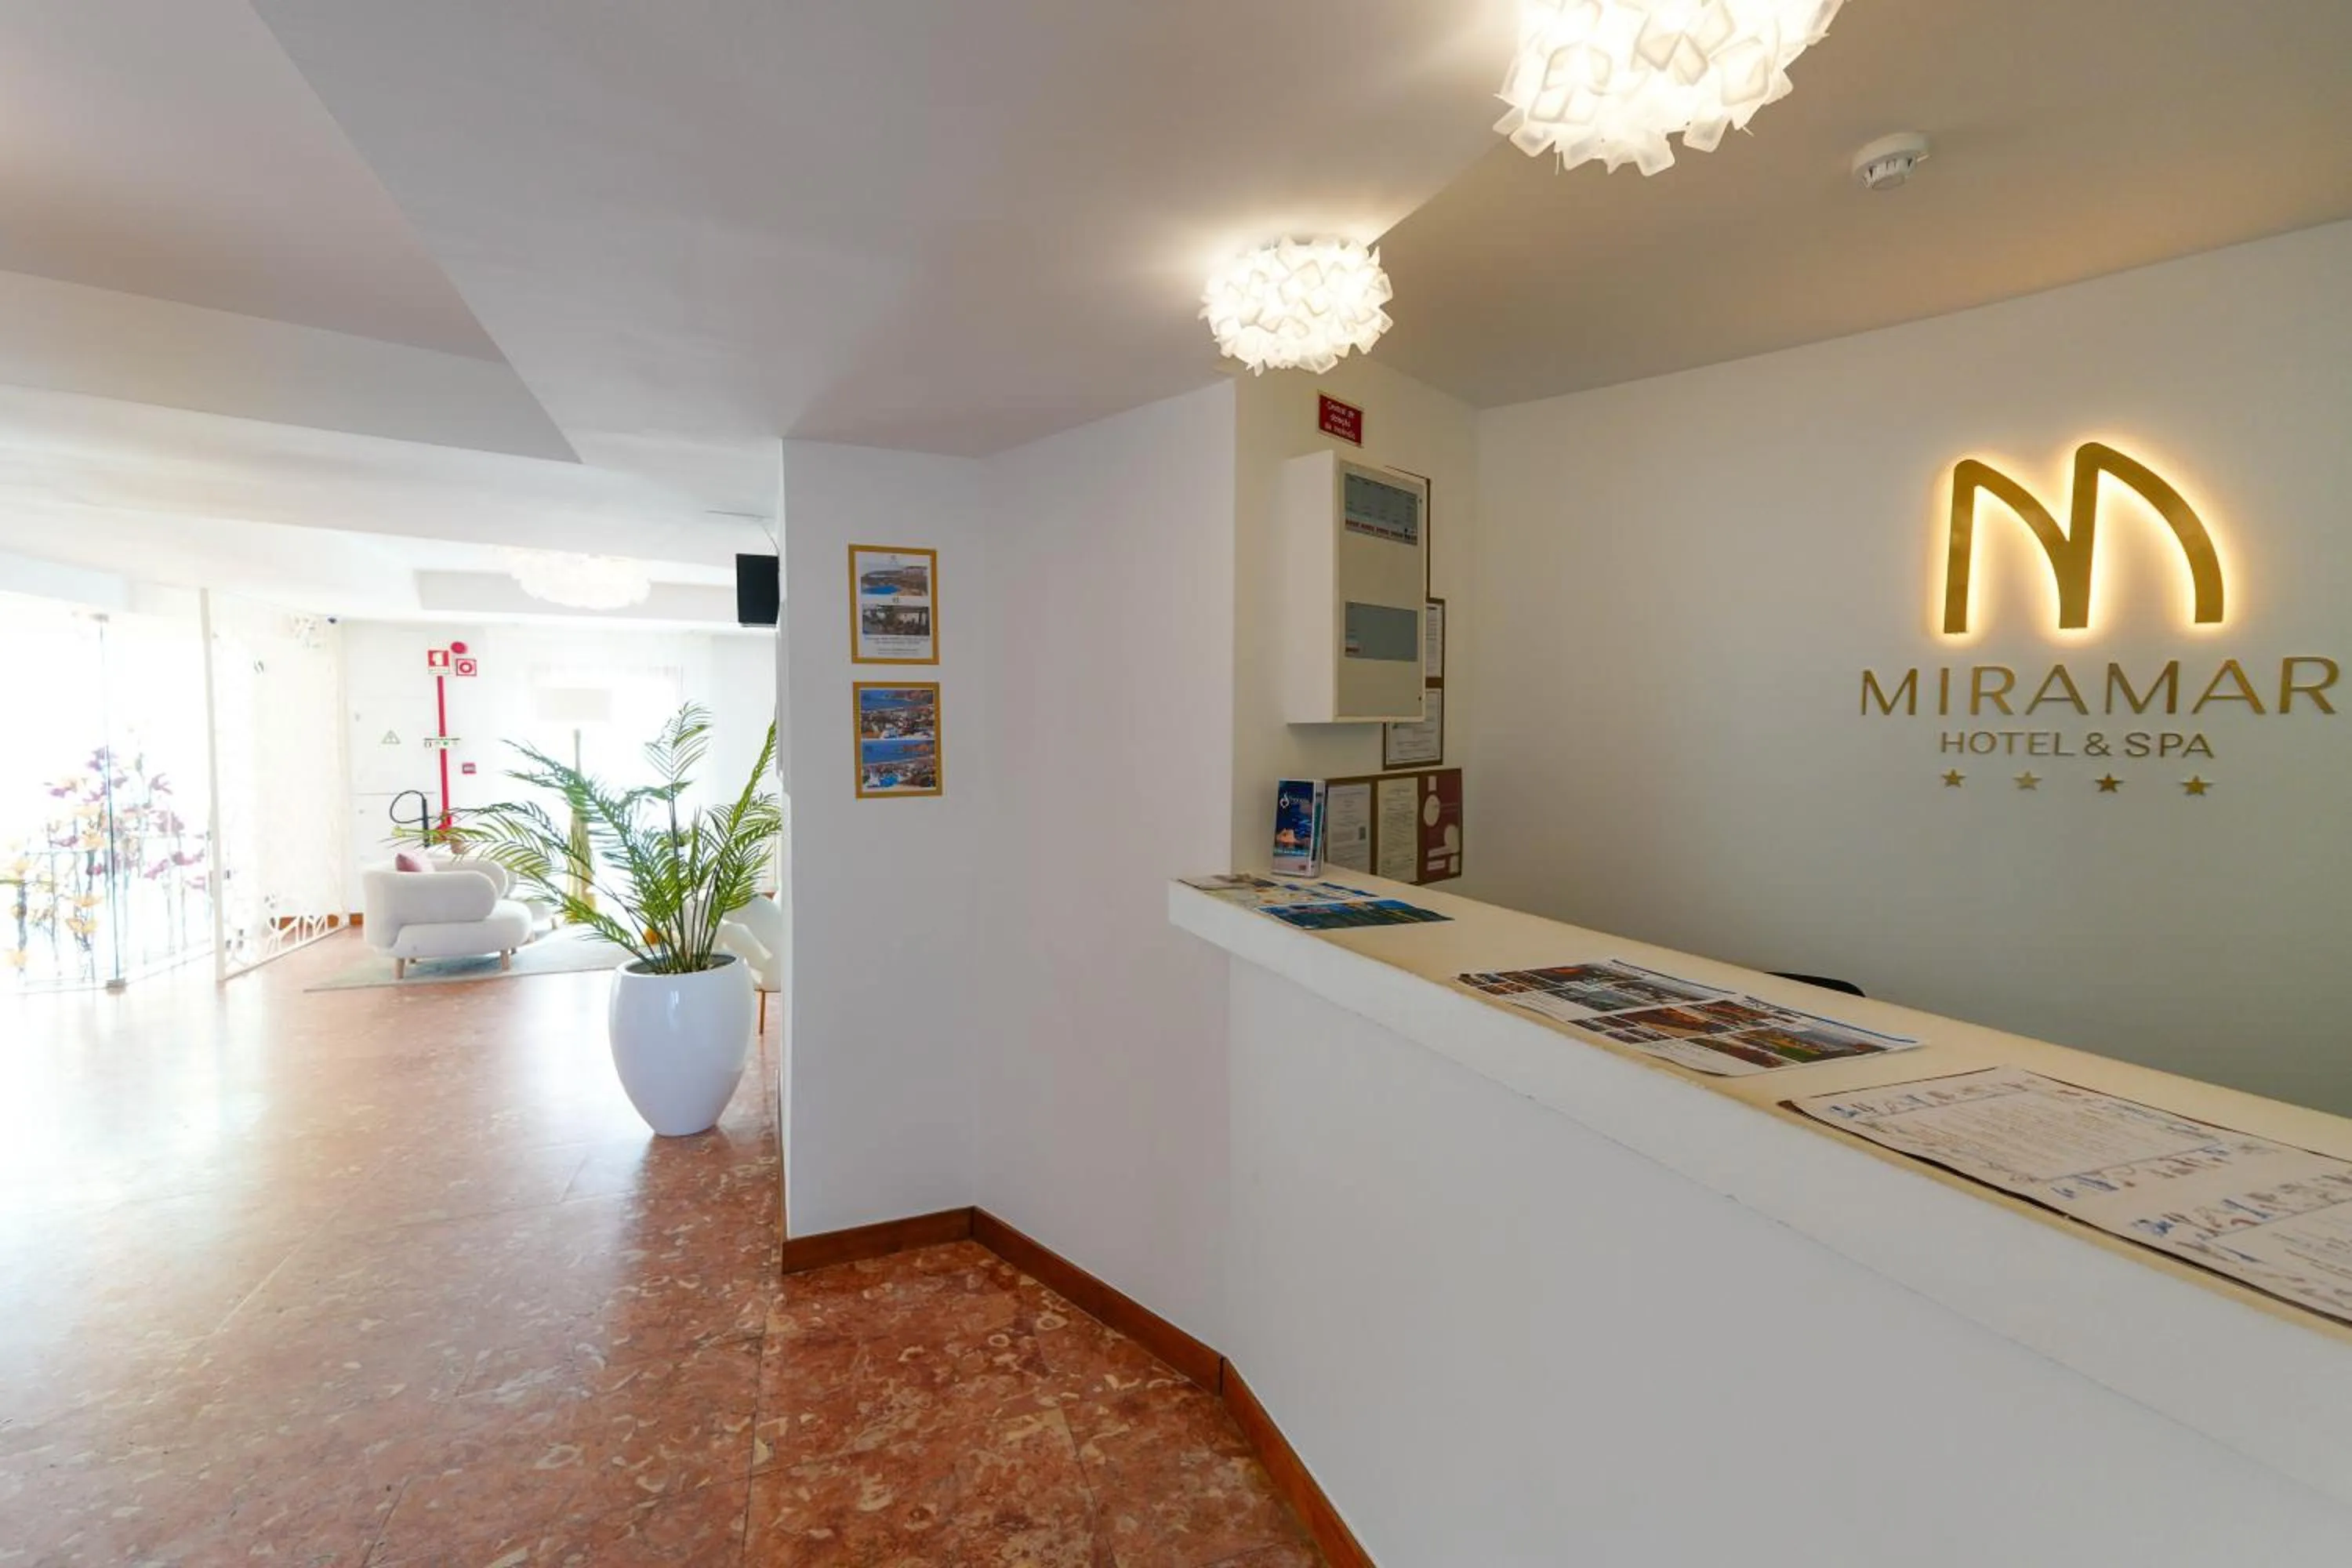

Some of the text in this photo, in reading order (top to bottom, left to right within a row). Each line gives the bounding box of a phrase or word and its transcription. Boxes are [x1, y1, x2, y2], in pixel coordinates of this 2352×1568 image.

[1860, 656, 2340, 717] MIRAMAR
[1940, 731, 2076, 757] HOTEL
[2124, 731, 2216, 759] SPA
